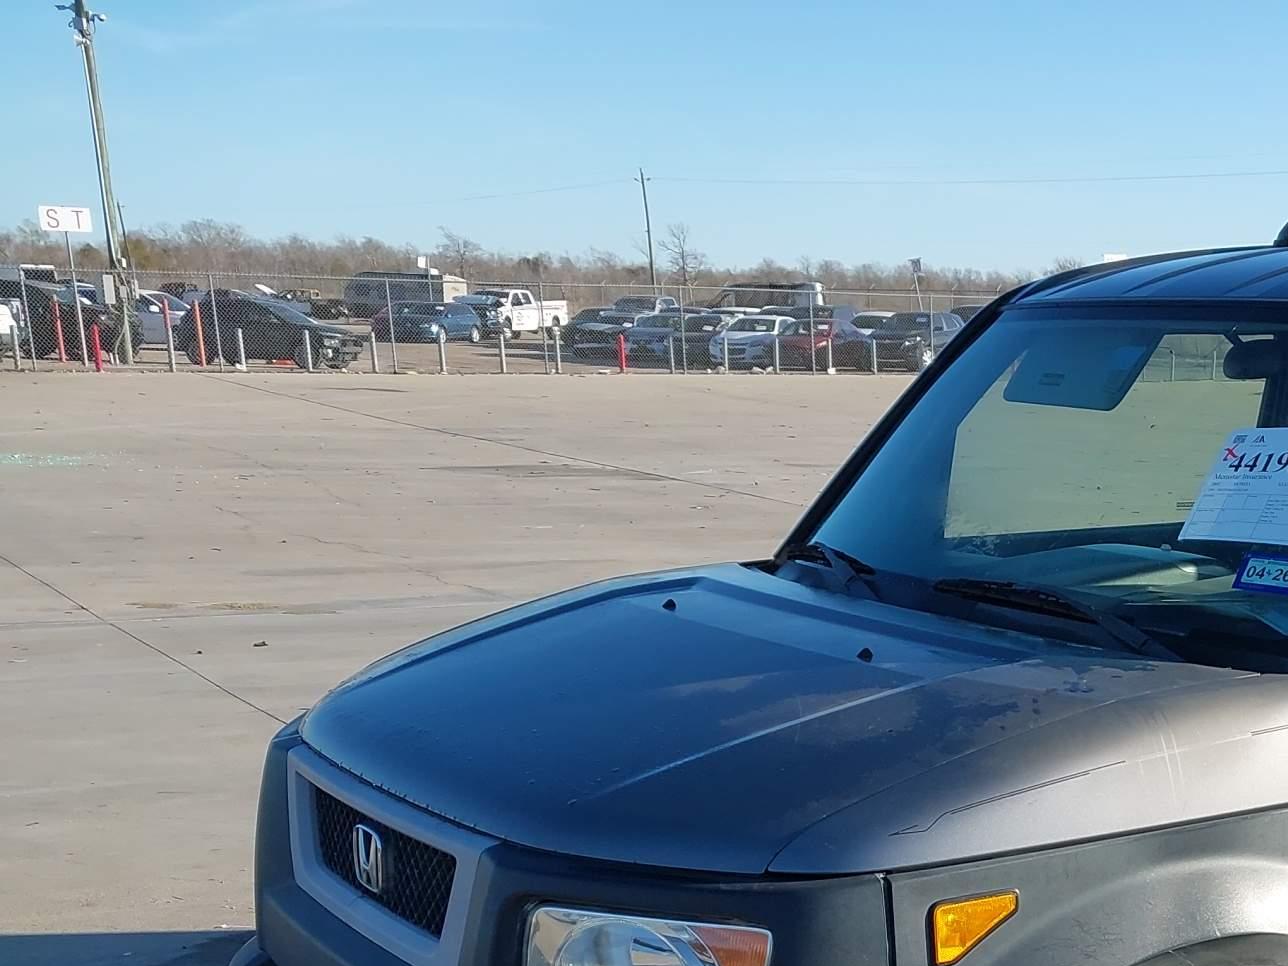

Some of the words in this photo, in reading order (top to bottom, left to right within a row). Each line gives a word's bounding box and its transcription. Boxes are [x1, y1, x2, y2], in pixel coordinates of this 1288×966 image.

[46, 208, 60, 229] S
[71, 210, 83, 230] T
[1246, 565, 1267, 580] 04
